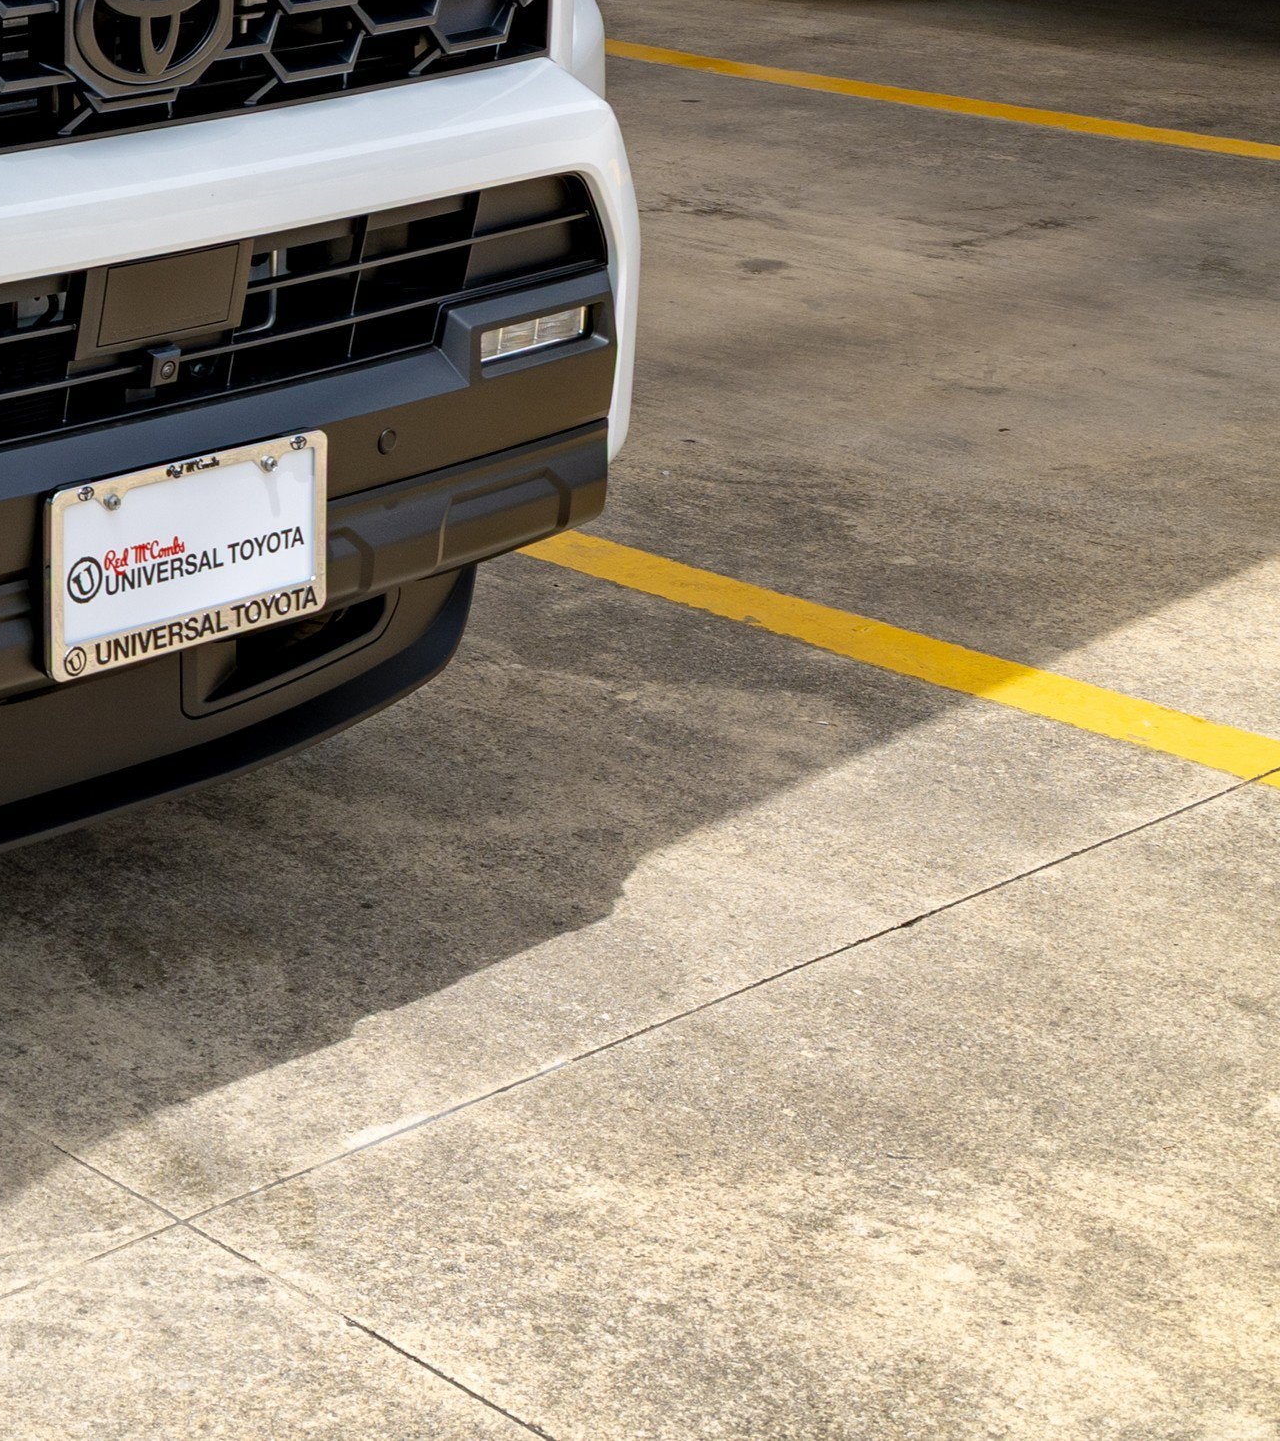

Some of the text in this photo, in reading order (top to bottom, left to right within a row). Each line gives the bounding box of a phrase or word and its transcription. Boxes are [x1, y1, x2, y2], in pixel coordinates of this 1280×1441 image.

[166, 464, 184, 478] Red
[104, 536, 185, 576] Red McCombs
[105, 548, 225, 596] UNIVERSAL
[228, 526, 304, 563] TOYOTA
[95, 609, 228, 665] UNIVERSAL
[230, 585, 318, 628] TOYOTA
